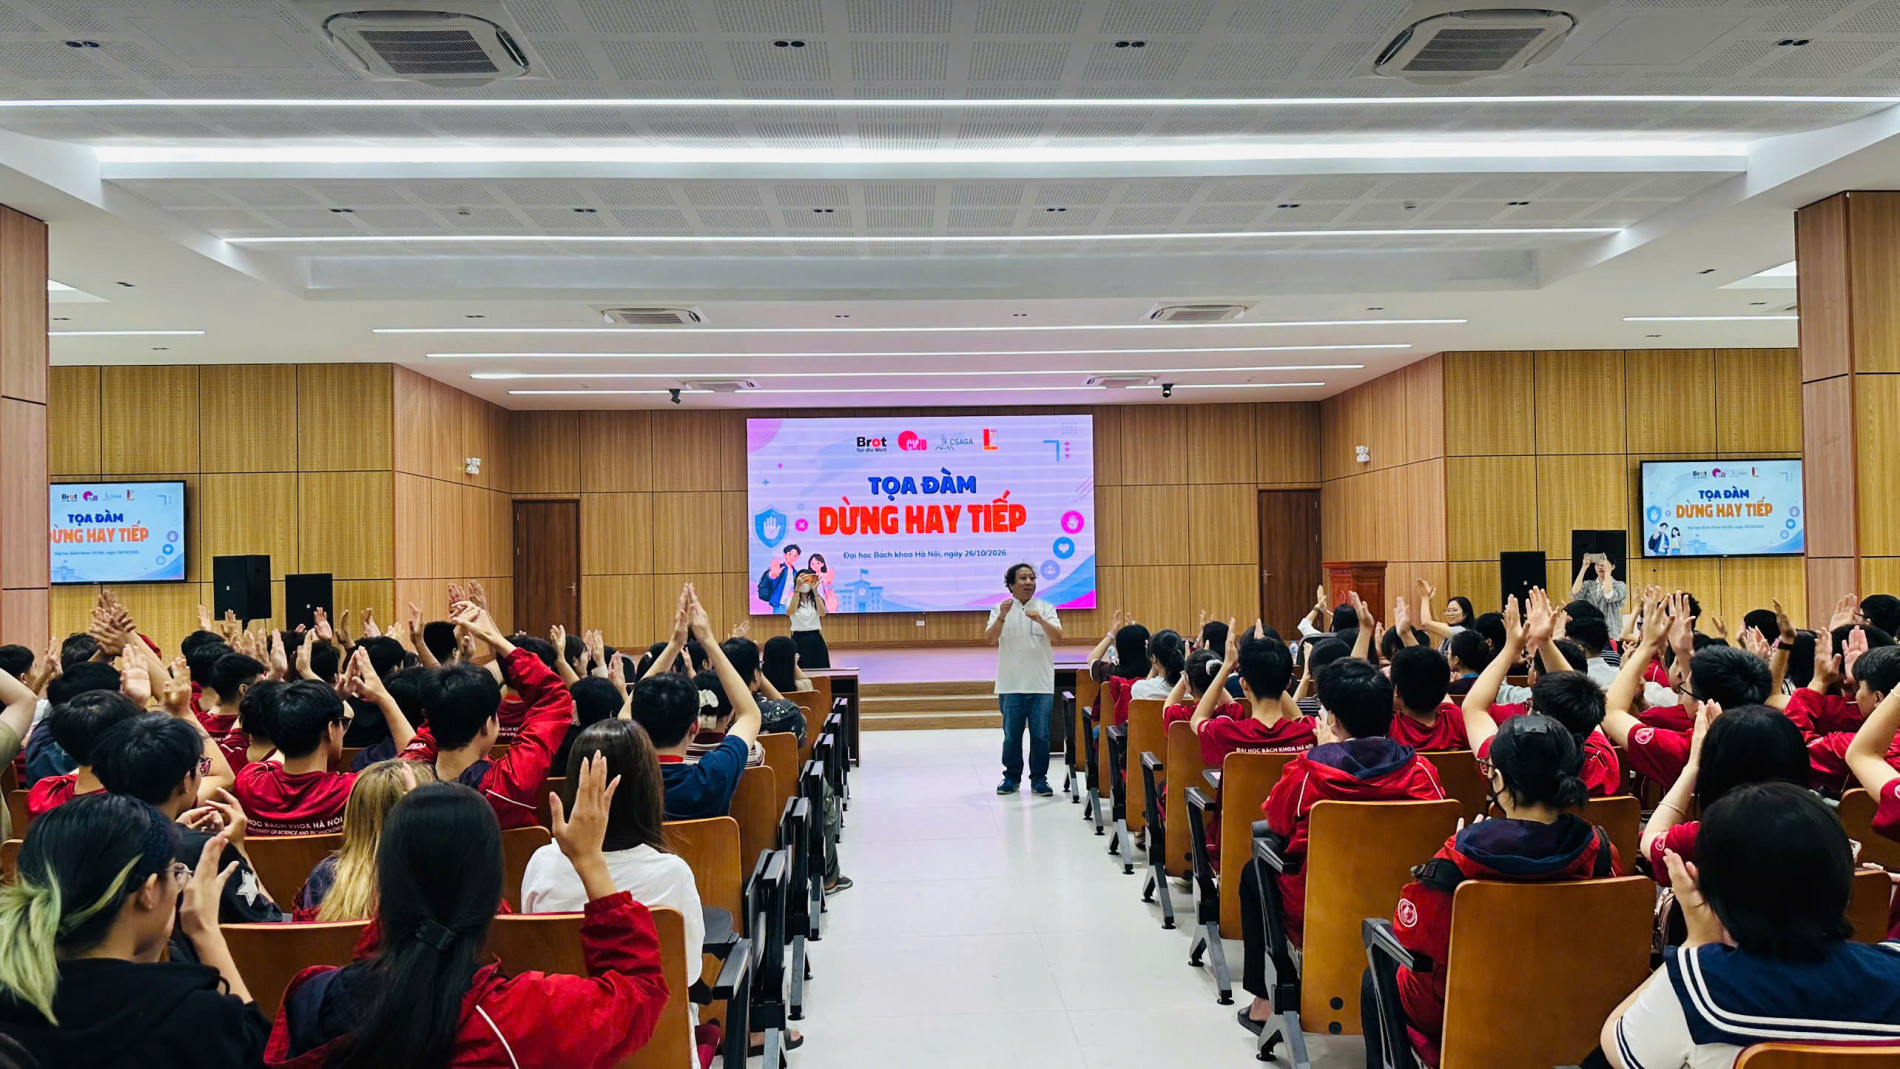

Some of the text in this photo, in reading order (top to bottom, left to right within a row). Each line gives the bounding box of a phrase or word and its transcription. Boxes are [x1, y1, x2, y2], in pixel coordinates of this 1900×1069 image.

[856, 436, 887, 447] Brot
[868, 467, 976, 501] TỌA ĐÀM
[1698, 486, 1750, 502] TỌA ĐÀM
[818, 490, 1026, 535] DỪNG HAY TIẾP
[1676, 496, 1773, 518] DỪNG HAY TIẾP
[68, 510, 124, 526] TỌA ĐÀM
[50, 520, 149, 543] ỪNG HAY TIẾP
[944, 550, 963, 559] ngày
[313, 820, 325, 828] HÀ
[327, 816, 343, 827] NỘI
